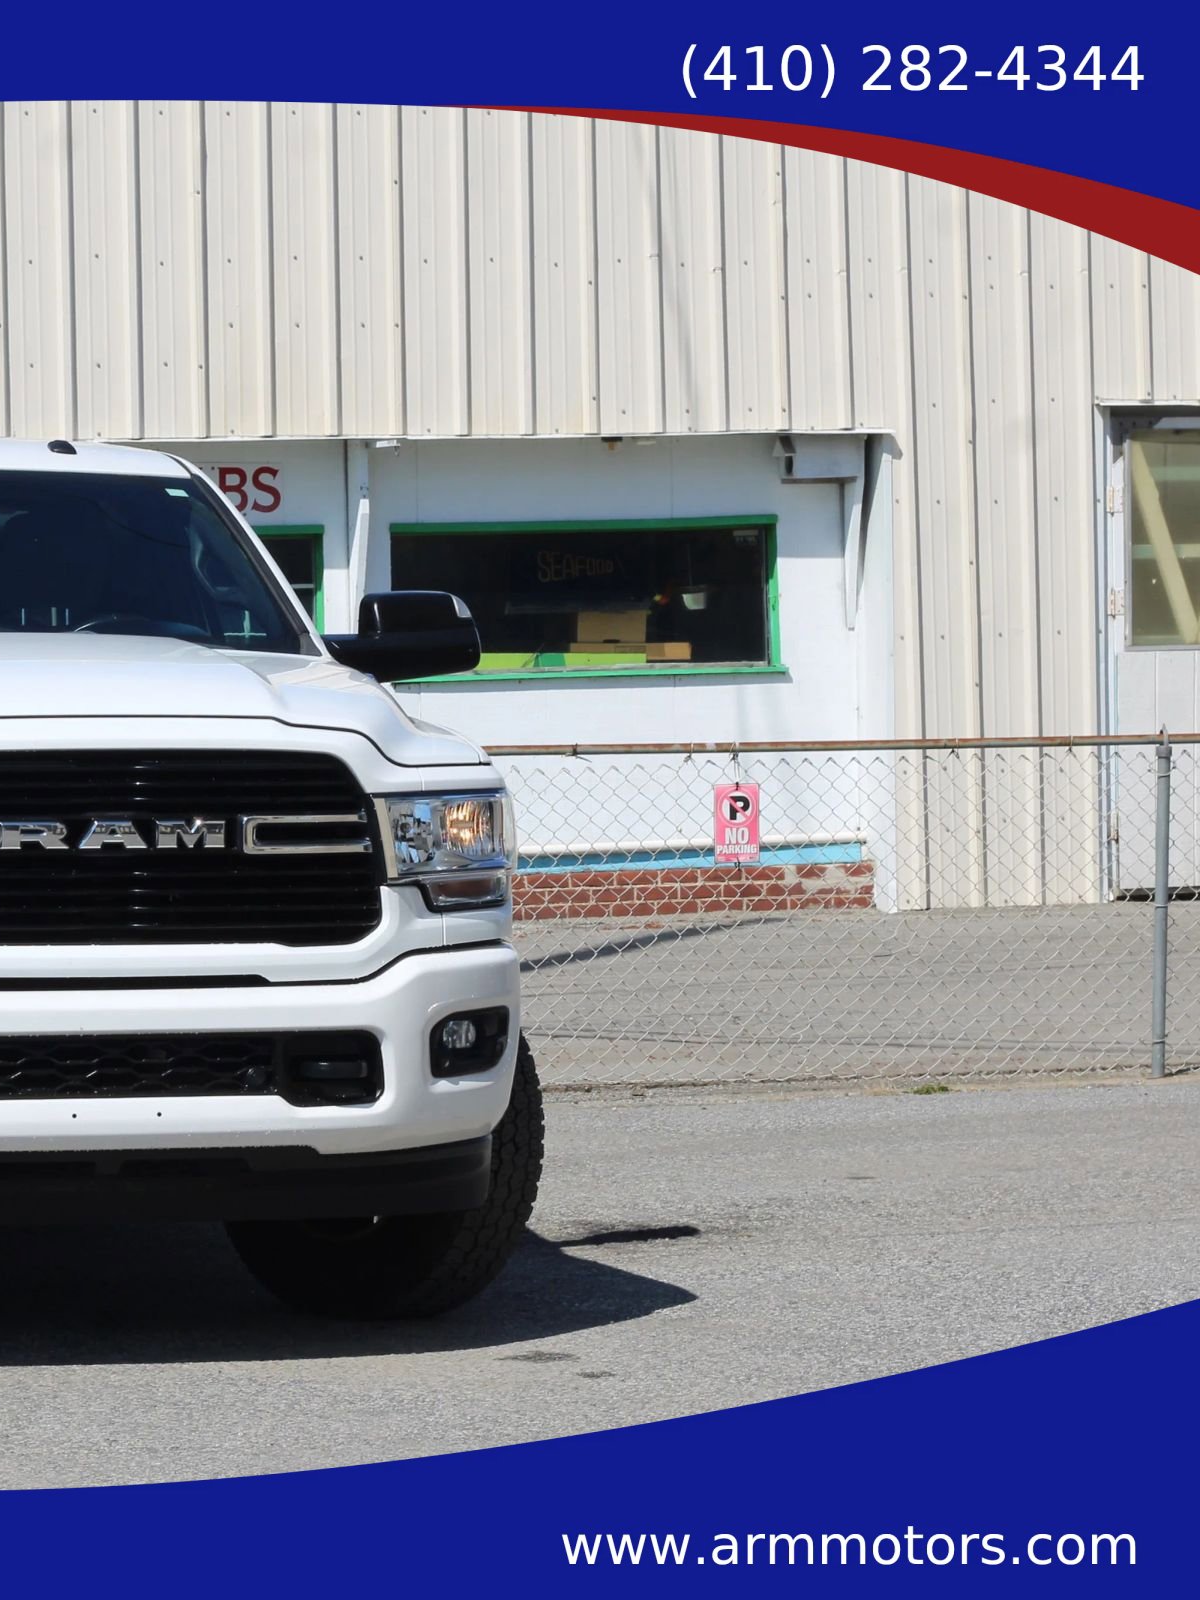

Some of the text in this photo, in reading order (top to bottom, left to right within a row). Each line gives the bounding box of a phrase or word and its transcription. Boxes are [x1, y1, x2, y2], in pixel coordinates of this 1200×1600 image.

[218, 466, 281, 513] BS
[536, 550, 615, 583] SEAFOOD
[0, 820, 225, 850] RAM
[716, 844, 757, 855] PARKING
[724, 827, 749, 844] NO
